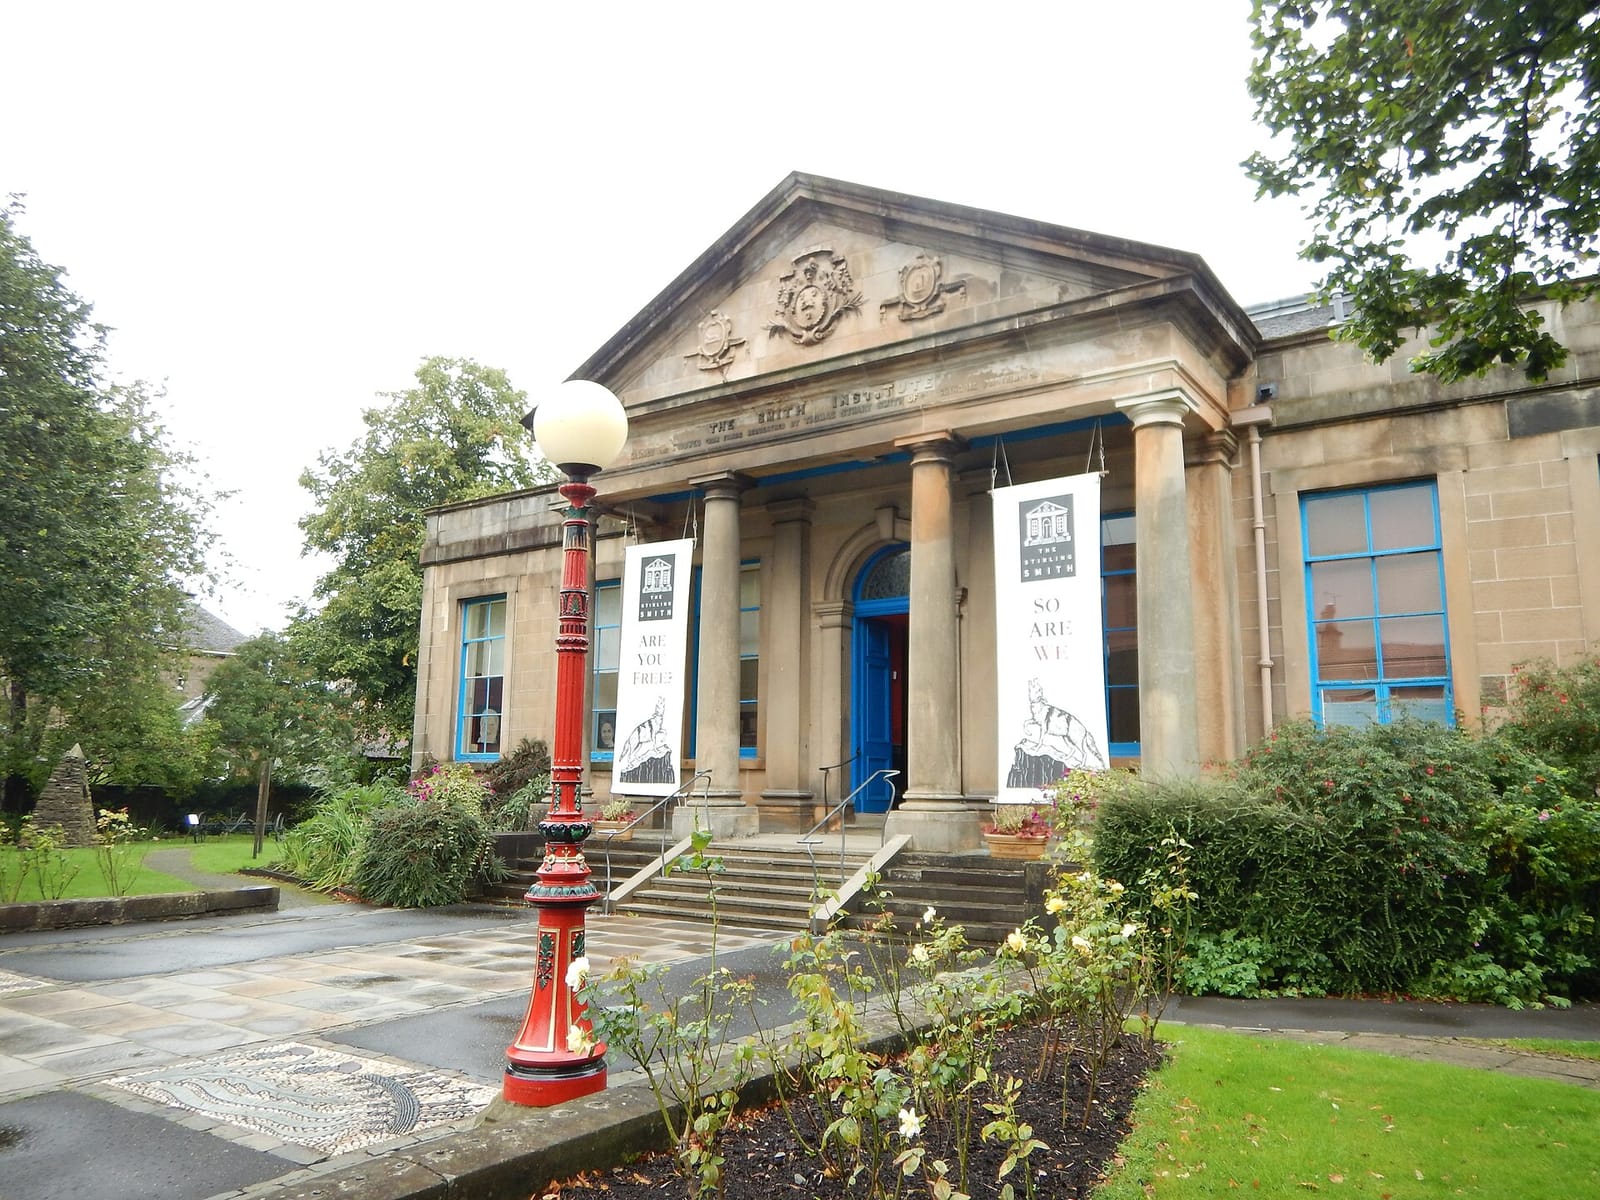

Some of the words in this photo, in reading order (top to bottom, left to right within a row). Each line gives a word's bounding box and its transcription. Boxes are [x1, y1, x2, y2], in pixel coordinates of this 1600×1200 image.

[709, 419, 736, 434] THE
[758, 401, 807, 424] SMITH
[832, 378, 934, 408] INSTITUTE
[1038, 546, 1057, 554] THE
[1024, 555, 1072, 565] STIRLING
[1024, 564, 1073, 577] SMITH
[1034, 598, 1060, 614] SO
[639, 609, 672, 618] SMITH
[1029, 620, 1073, 638] ARE
[639, 634, 666, 648] ARE
[637, 653, 666, 666] YOU
[1033, 645, 1070, 662] WE
